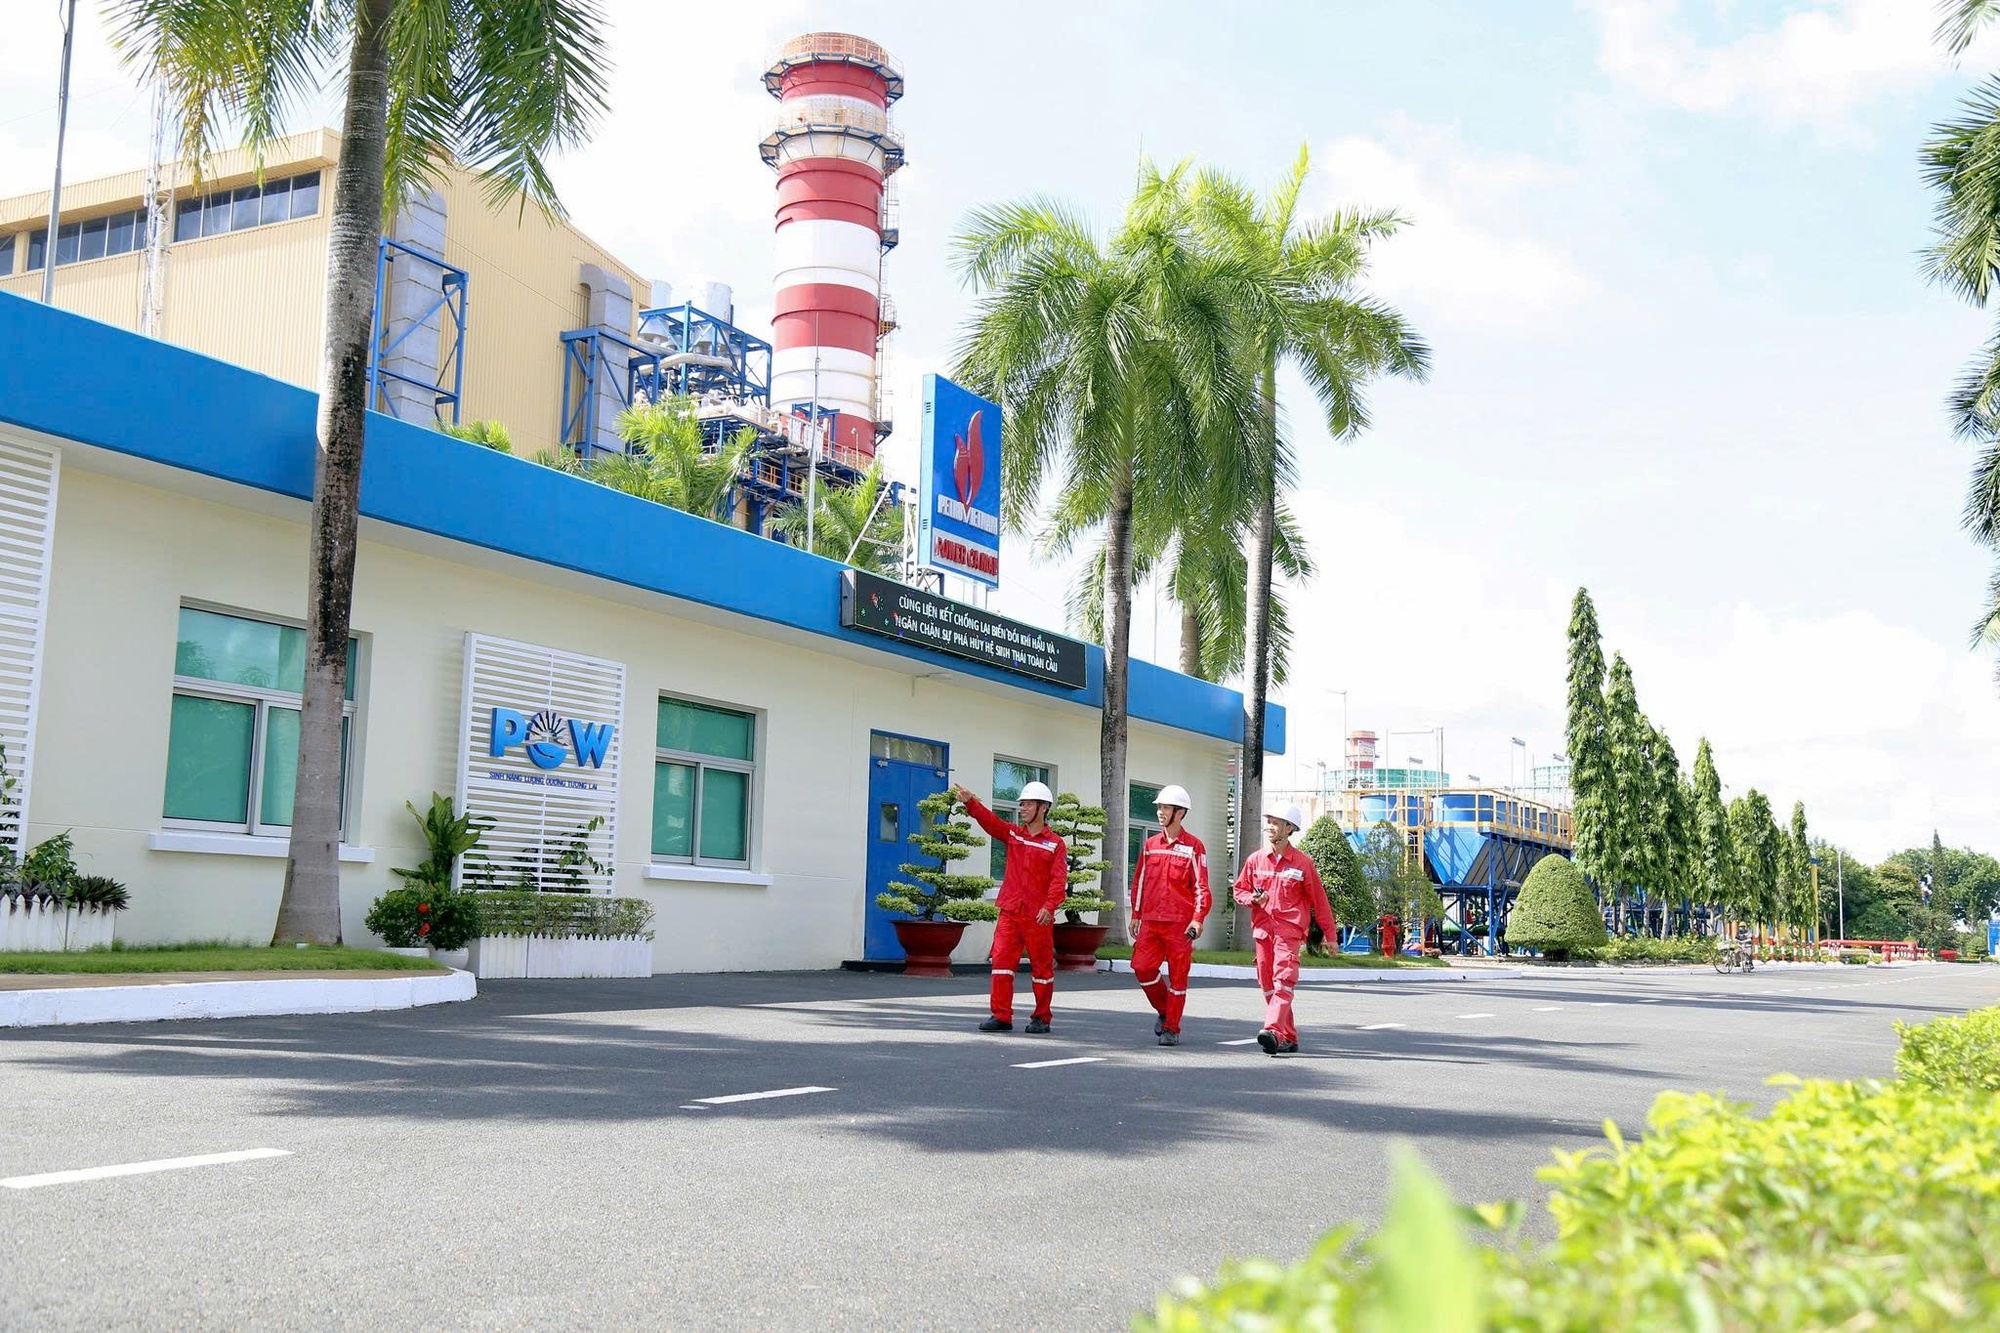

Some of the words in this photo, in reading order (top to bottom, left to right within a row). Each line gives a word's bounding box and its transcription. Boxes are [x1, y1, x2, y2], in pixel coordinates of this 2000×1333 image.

[895, 614, 918, 633] NGĂN
[919, 621, 940, 640] CHẶN
[953, 632, 969, 648] PHÁ
[1011, 649, 1026, 665] THÁI
[1026, 654, 1045, 670] TOÀN
[1045, 656, 1058, 673] CẦU
[898, 594, 922, 614] CÙNG
[939, 606, 954, 623] KẾT
[953, 611, 979, 632] CHỐNG
[980, 621, 991, 636] LẠI
[991, 623, 1007, 640] BIẾN
[1046, 641, 1057, 655] VÀ
